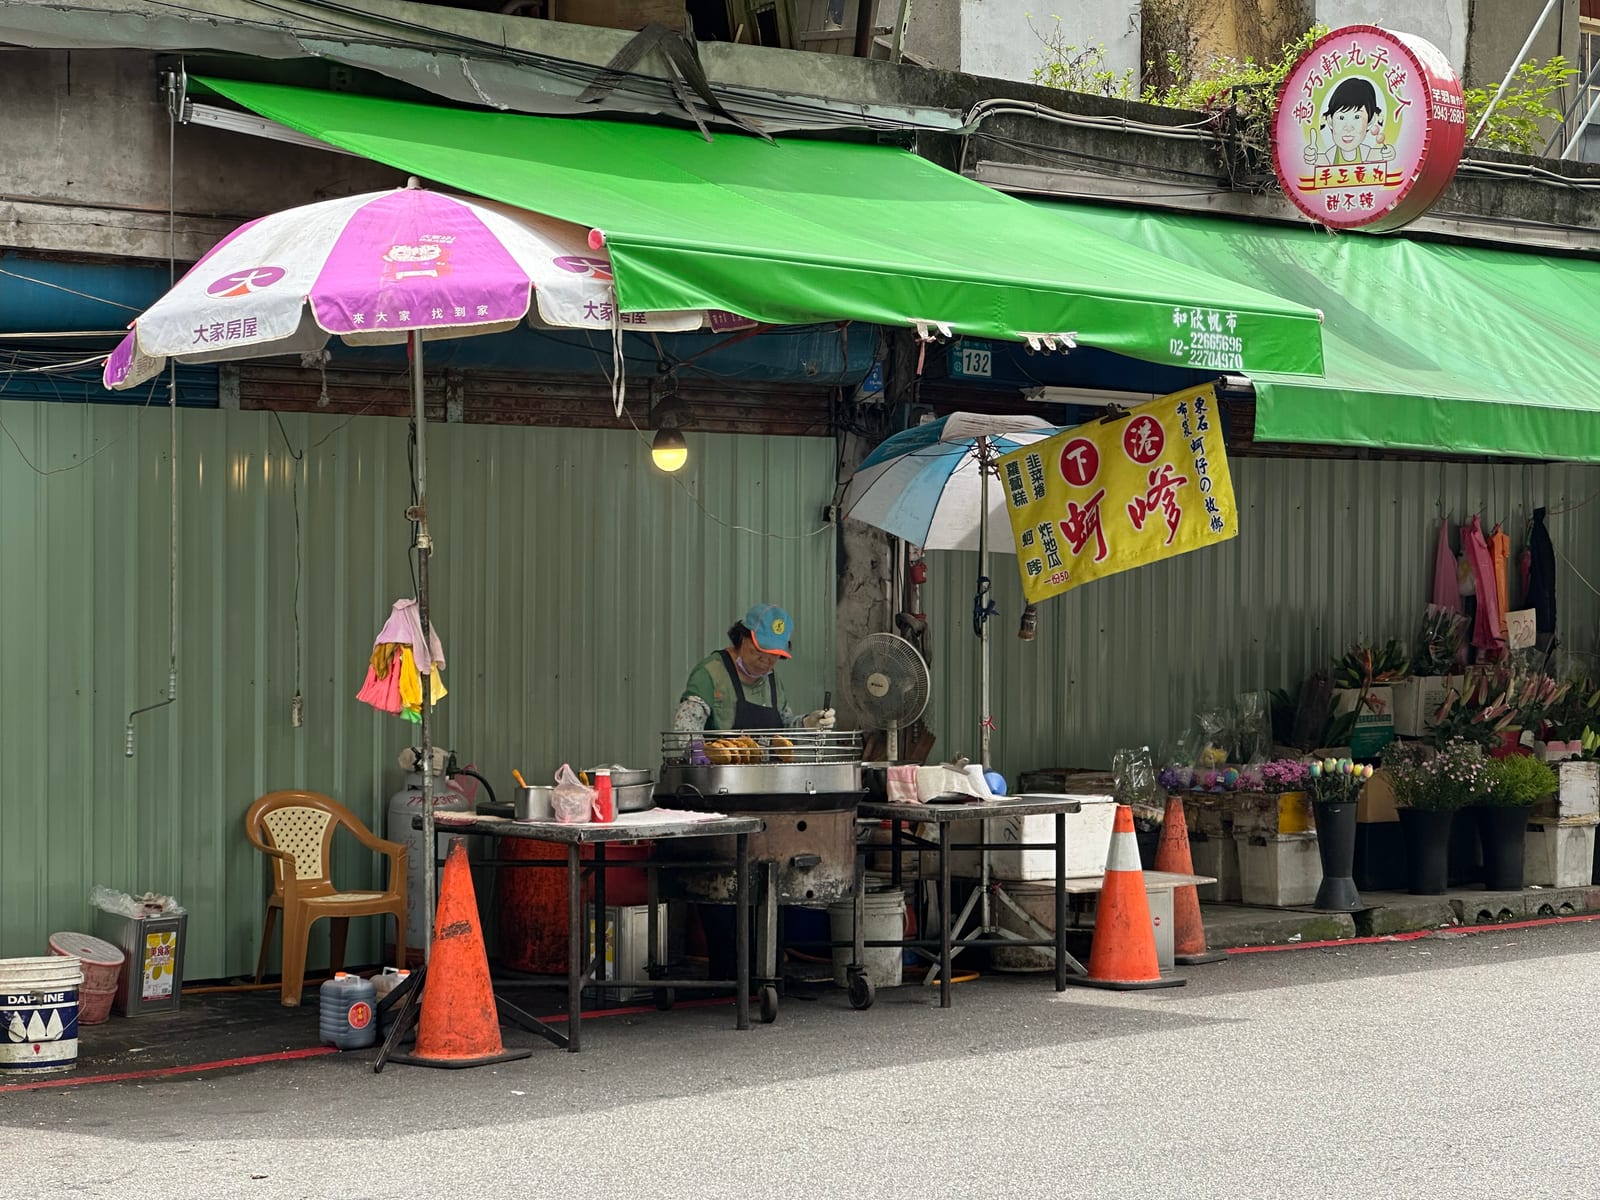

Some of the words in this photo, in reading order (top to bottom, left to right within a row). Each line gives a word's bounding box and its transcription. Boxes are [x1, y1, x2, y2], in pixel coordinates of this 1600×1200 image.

[1319, 165, 1384, 186] 手工貢丸
[1326, 192, 1375, 211] 甜不辣
[192, 317, 257, 345] 大家房屋
[1172, 307, 1237, 334] 和欣帆布
[965, 351, 990, 374] 132
[1038, 522, 1063, 569] 炸地瓜
